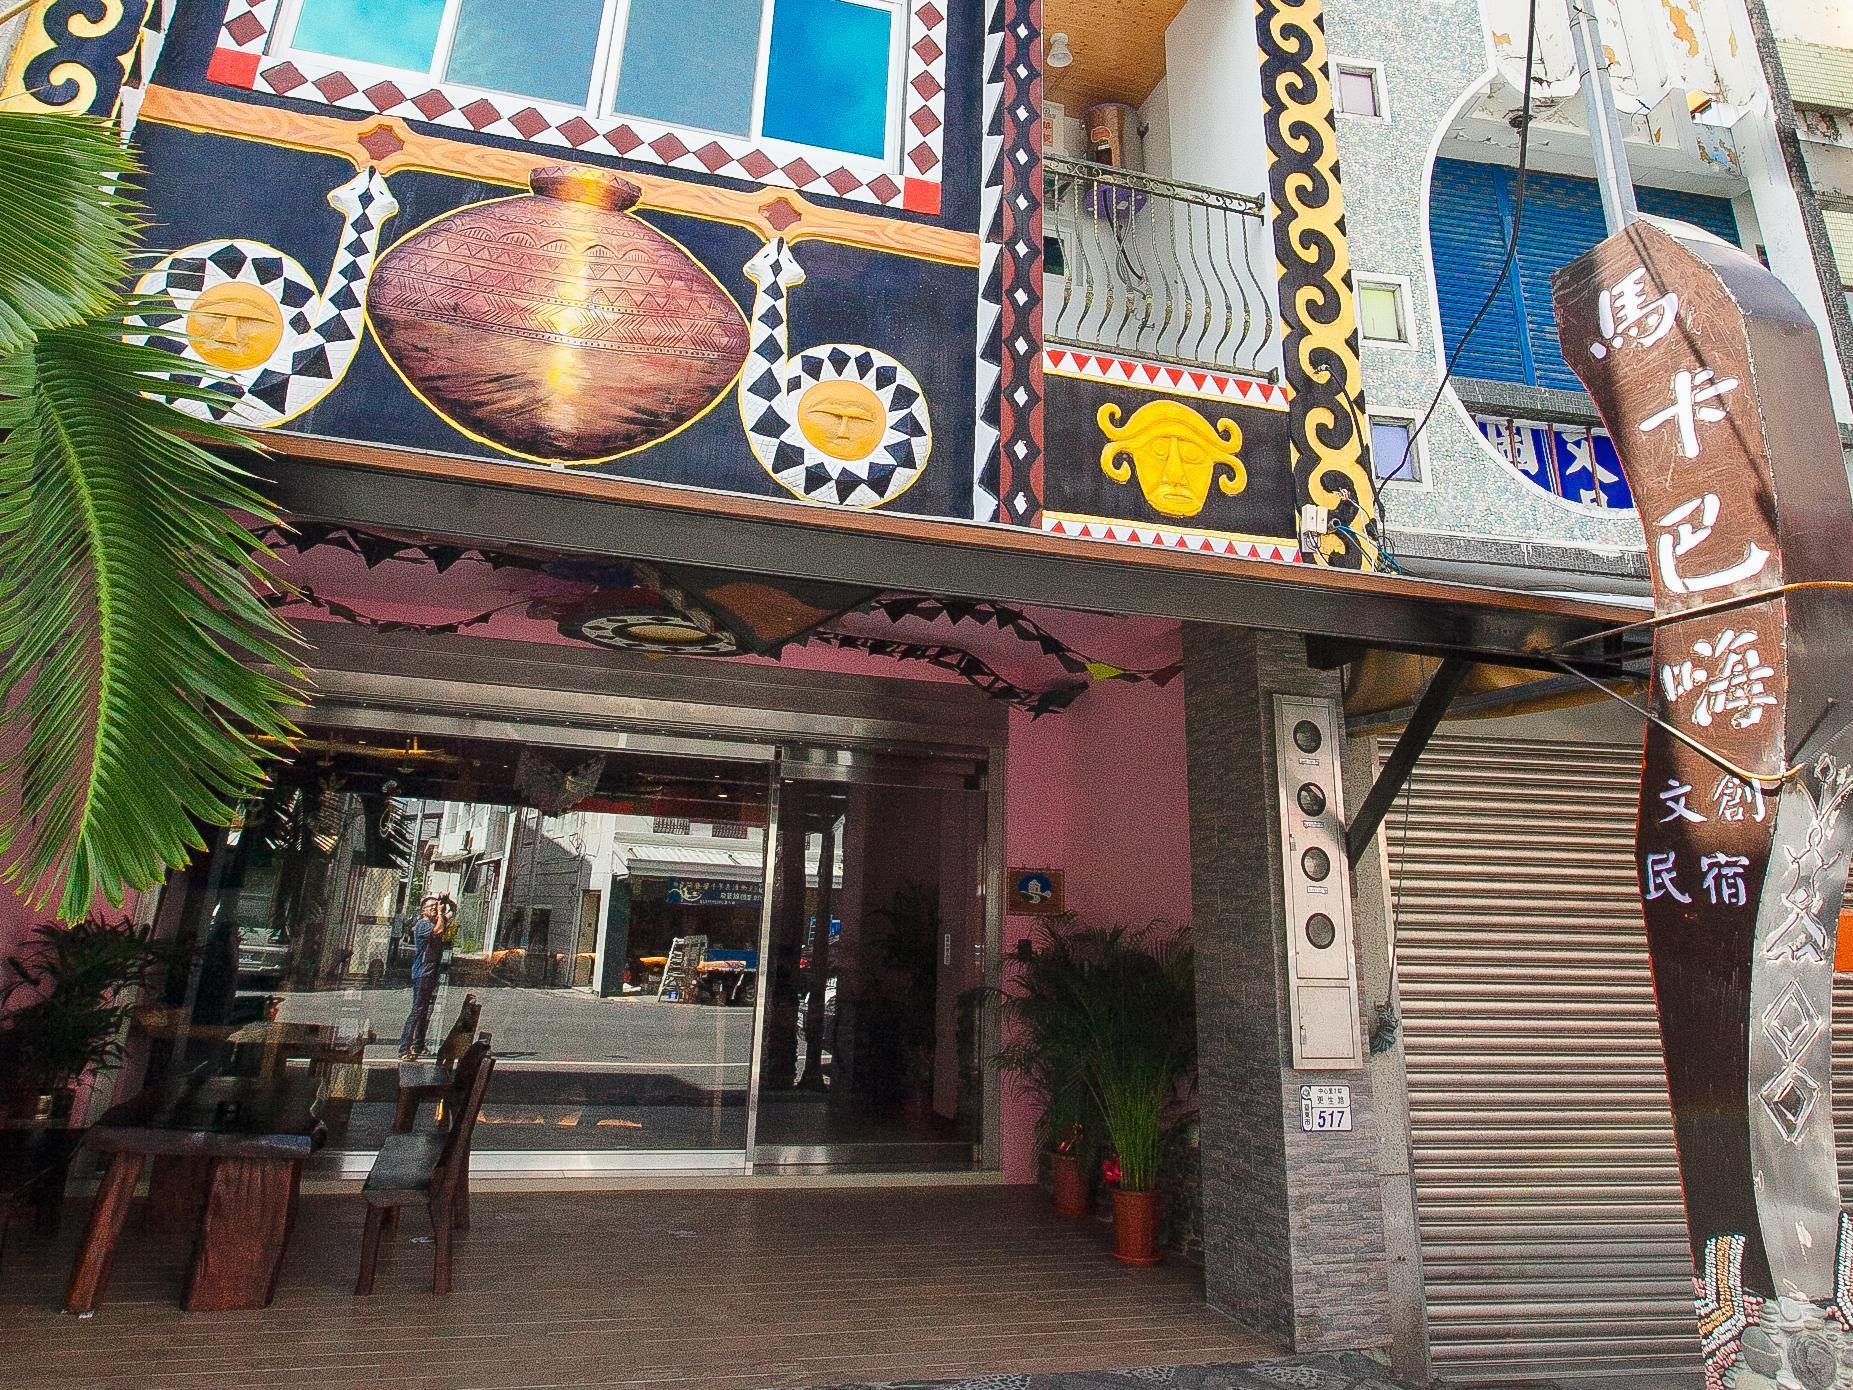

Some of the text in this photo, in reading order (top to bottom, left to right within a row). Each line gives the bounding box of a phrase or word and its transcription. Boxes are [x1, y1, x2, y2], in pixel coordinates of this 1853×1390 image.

[1659, 774, 1766, 822] 文創
[1645, 850, 1749, 905] 民宿
[1317, 1096, 1345, 1105] 更生路
[1318, 1110, 1345, 1128] 517
